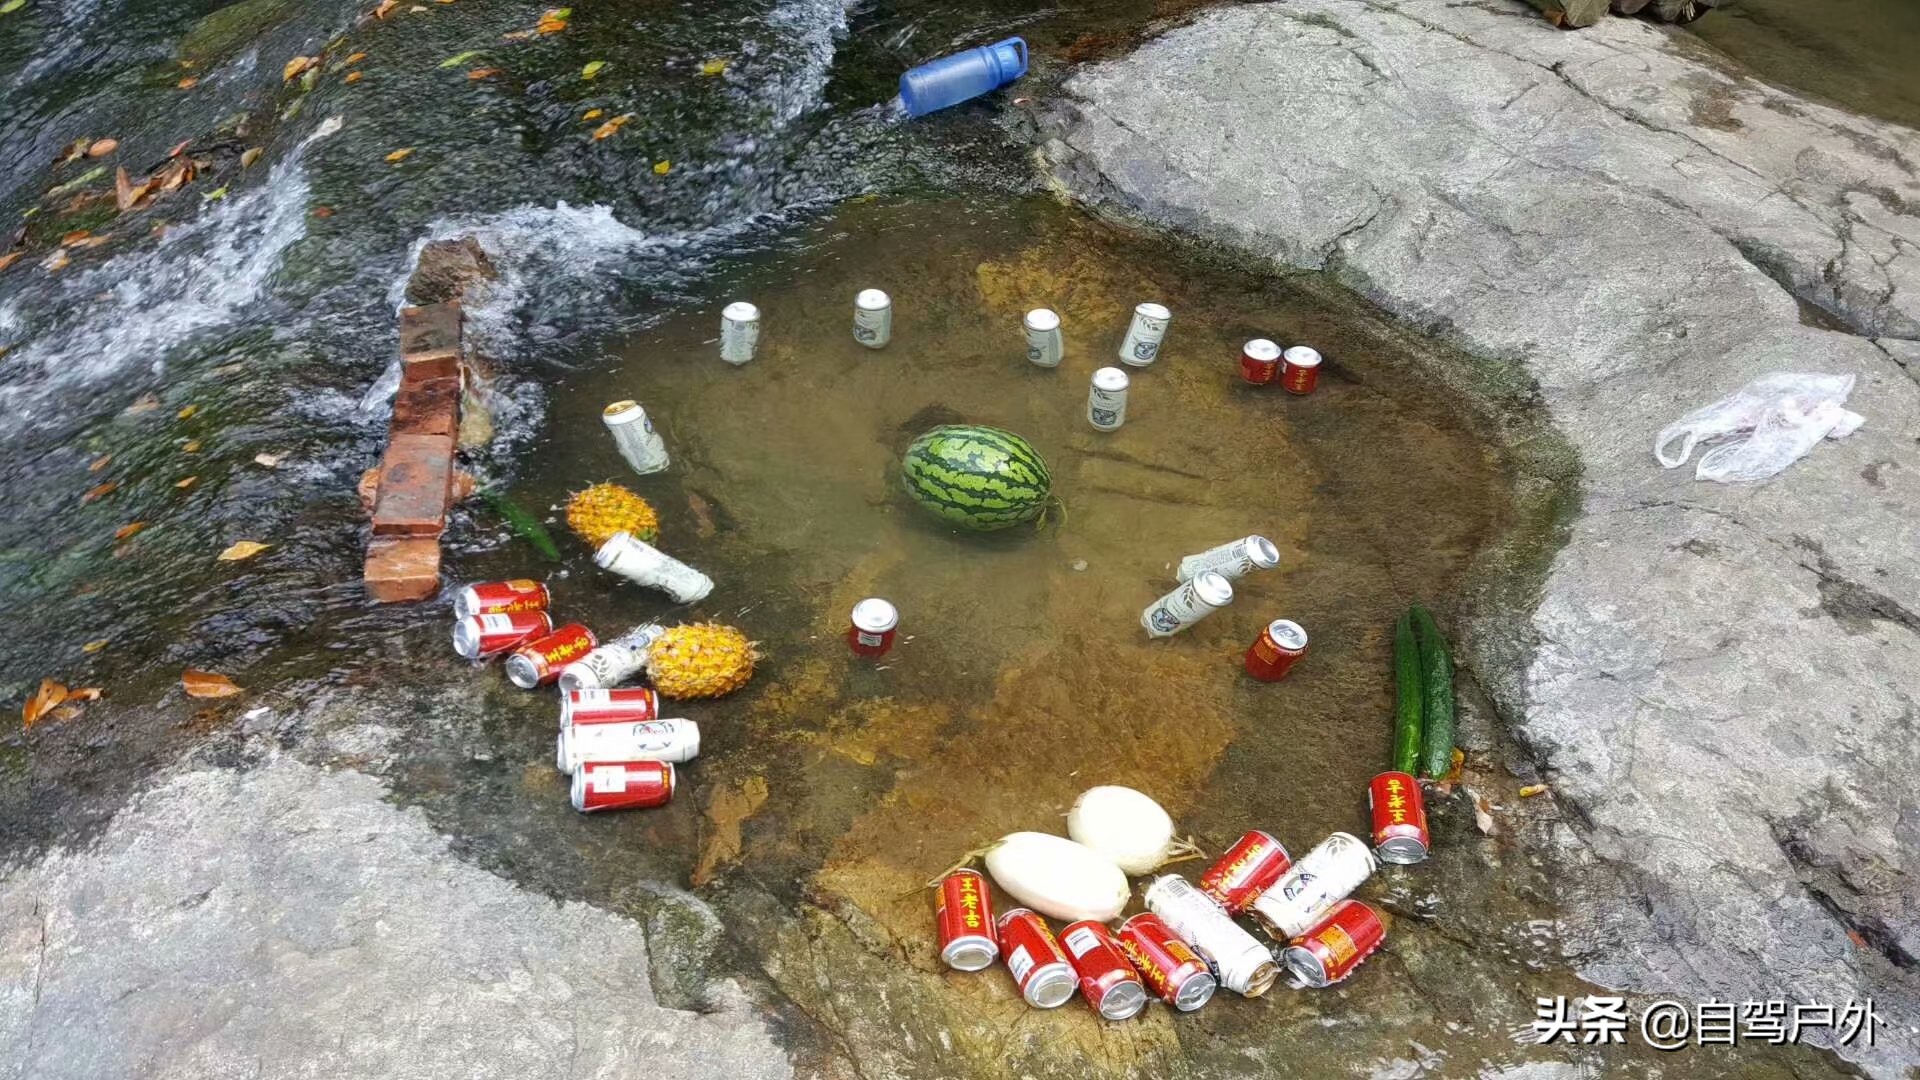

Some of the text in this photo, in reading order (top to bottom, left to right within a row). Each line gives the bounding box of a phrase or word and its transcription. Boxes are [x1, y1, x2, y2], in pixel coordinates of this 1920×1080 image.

[545, 637, 589, 663] 王老吉
[1385, 779, 1406, 823] 王老吉
[960, 877, 980, 928] 王老吉
[1123, 939, 1166, 983] 王老吉
